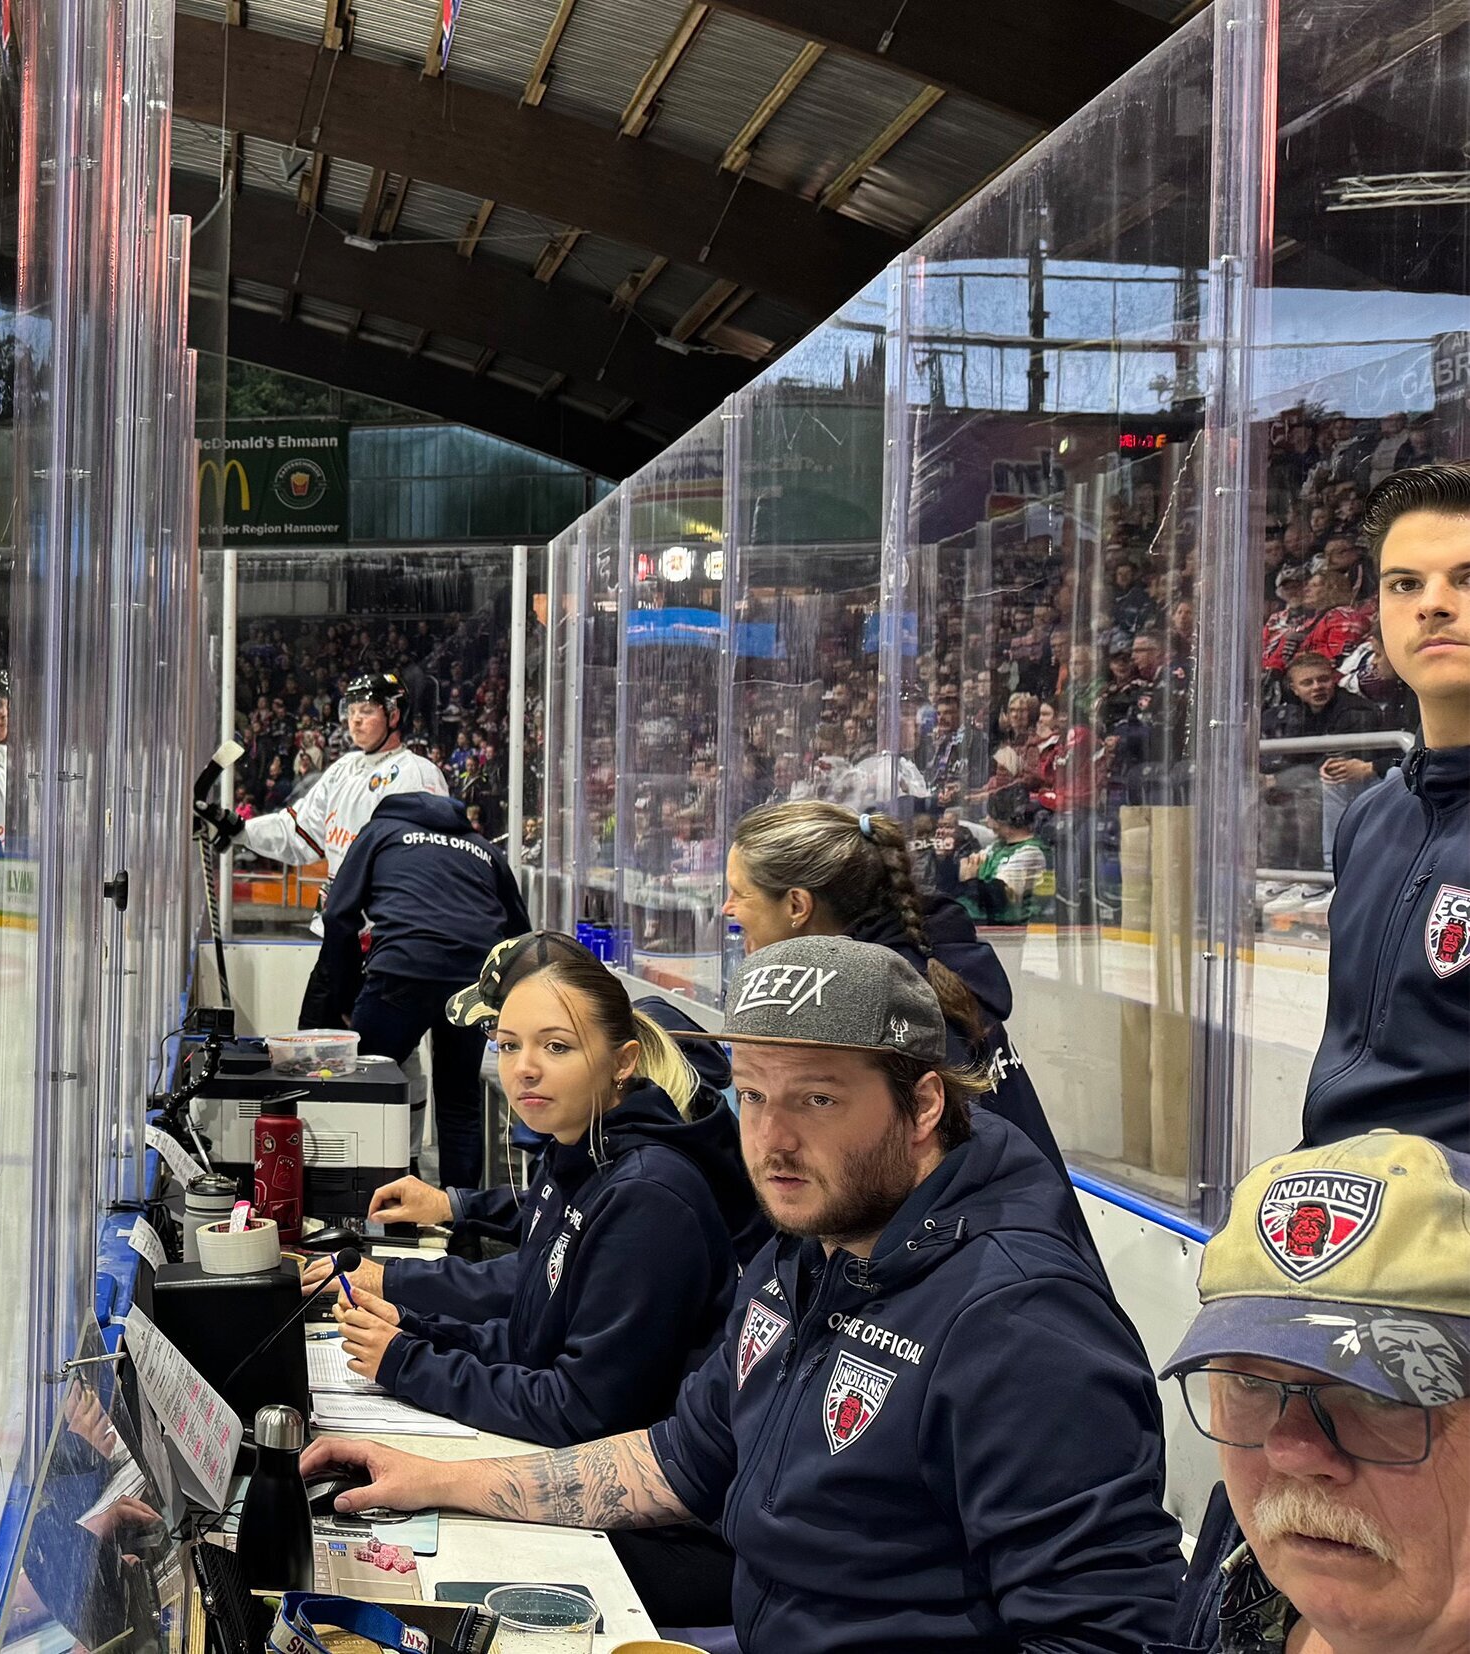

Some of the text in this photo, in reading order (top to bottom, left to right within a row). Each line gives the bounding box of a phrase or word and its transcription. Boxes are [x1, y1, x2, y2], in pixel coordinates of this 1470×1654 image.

[278, 436, 338, 448] Ehmann
[222, 525, 239, 534] der
[242, 524, 282, 536] Region
[284, 523, 339, 534] Hannover
[403, 832, 493, 867] OFF-ICE OFFICIAL
[1272, 1180, 1368, 1205] INDIANS
[749, 1311, 779, 1343] ECH
[861, 1324, 925, 1365] OFFICIAL
[840, 1366, 885, 1399] INDIANS
